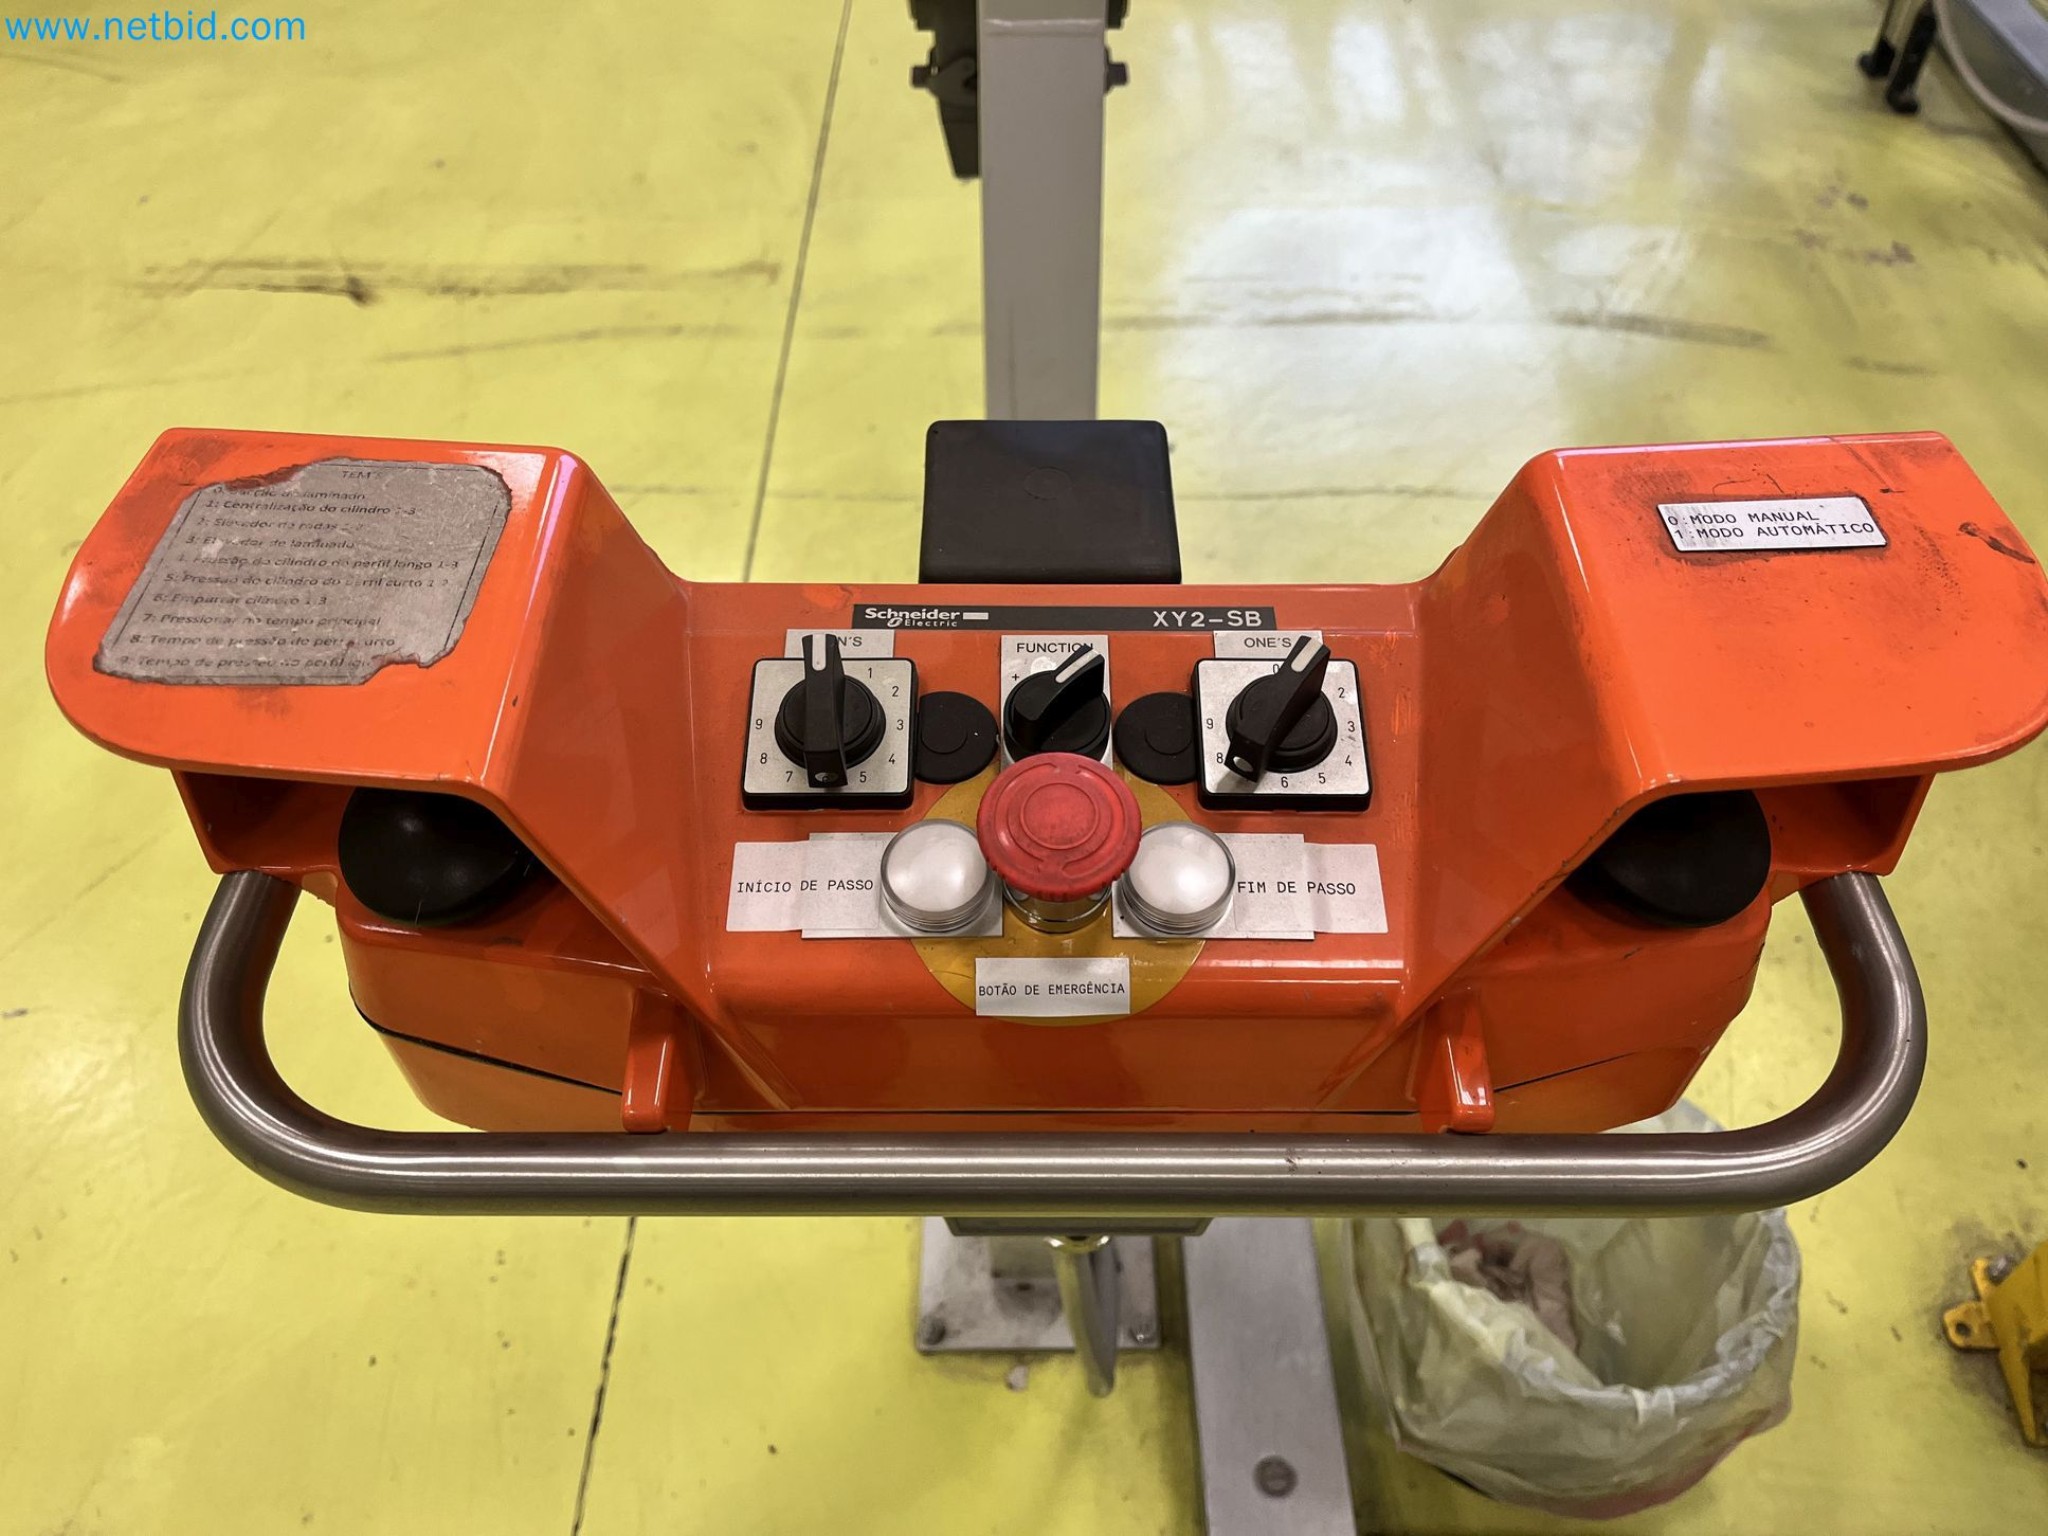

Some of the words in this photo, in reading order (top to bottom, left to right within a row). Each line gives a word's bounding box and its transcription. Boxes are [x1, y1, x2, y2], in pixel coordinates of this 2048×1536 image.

[223, 501, 316, 513] Centralização
[320, 504, 338, 513] do
[340, 506, 392, 515] cilindro
[1747, 511, 1820, 523] MANUAL
[1756, 522, 1875, 537] AUTOMÁTICO
[203, 537, 263, 547] Elvador
[273, 557, 327, 567] cilindro
[352, 559, 391, 569] perfil
[393, 559, 433, 570] longo
[164, 573, 179, 582] 5:
[242, 576, 261, 585] do
[264, 576, 318, 586] cilindro
[384, 579, 423, 588] curto
[142, 613, 155, 623] 7:
[865, 608, 961, 620] Schneider
[1153, 611, 1263, 627] XY2-SB
[904, 619, 959, 627] Electric
[130, 634, 144, 644] 8:
[150, 634, 202, 645] Tempo
[1244, 637, 1292, 648] ONE'S
[867, 667, 873, 679] 1
[891, 685, 900, 698] 2
[1338, 687, 1346, 699] 2
[755, 718, 763, 730] 9
[896, 719, 904, 731] 3
[1206, 718, 1214, 730] 9
[1347, 721, 1356, 733] 3
[759, 753, 768, 765] 8
[888, 753, 897, 765] 4
[1216, 753, 1224, 764] 8
[1344, 755, 1353, 766] 4
[785, 771, 794, 783] 7
[859, 771, 867, 783] 5
[1280, 777, 1289, 789] 6
[1318, 773, 1327, 785] 5
[737, 879, 792, 893] INÍCIO
[800, 880, 818, 891] DE
[827, 880, 874, 891] PASSO
[1237, 881, 1267, 893] FIM
[1277, 881, 1297, 893] DE
[1307, 881, 1356, 895] PASSO
[978, 982, 1017, 996] BOTÃO
[1025, 984, 1040, 996] DE
[1048, 981, 1125, 995] EMERGÊNCIA
